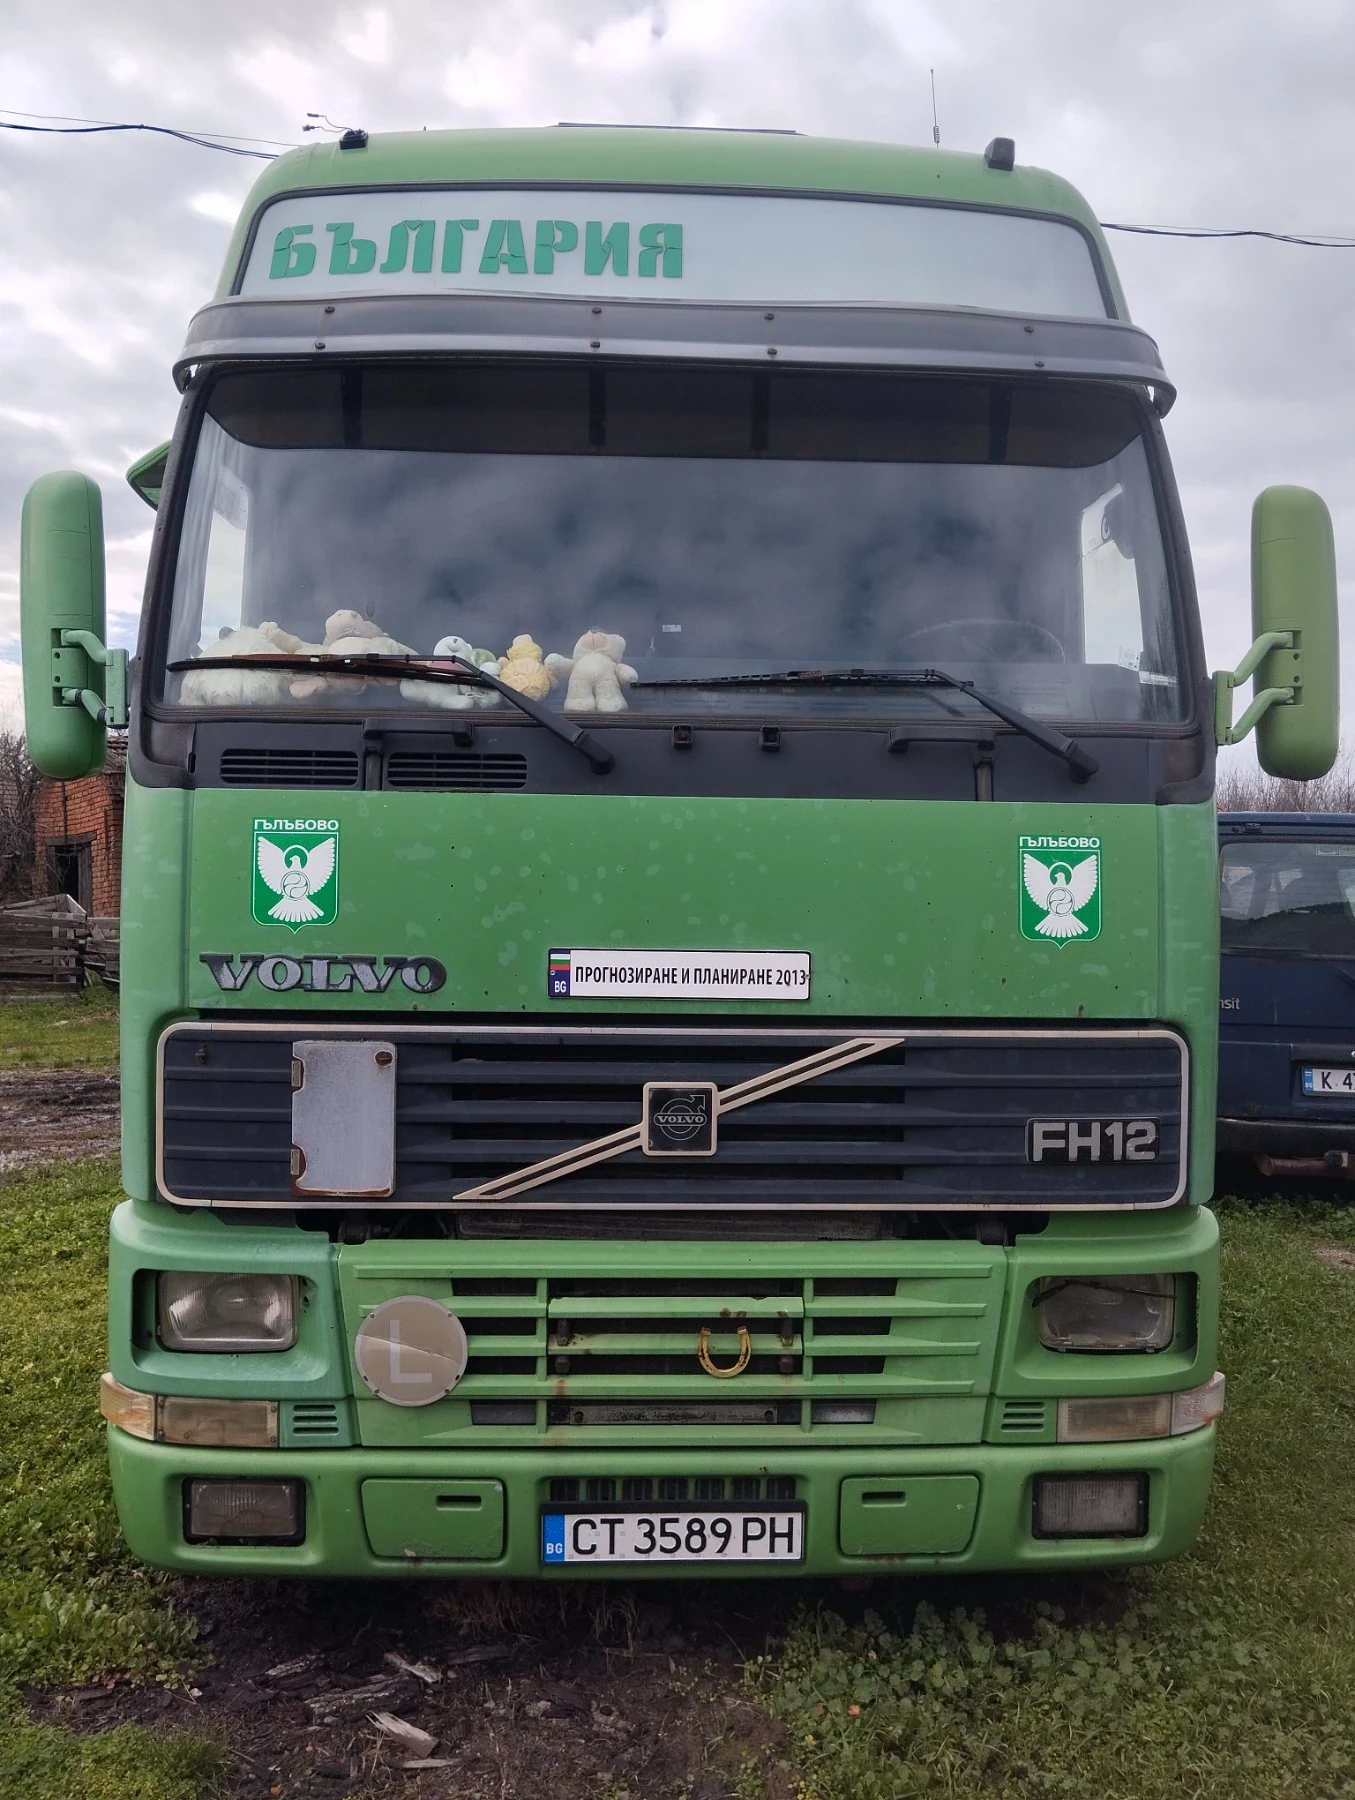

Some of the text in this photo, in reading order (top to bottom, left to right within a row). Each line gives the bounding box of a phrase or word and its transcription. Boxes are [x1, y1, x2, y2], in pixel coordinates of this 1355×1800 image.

[269, 219, 683, 280] БЪЛГАРИЯ
[254, 819, 340, 831] ГЪЛЪБОВО
[1019, 836, 1100, 848] ГЪЛЪБОВО
[199, 953, 447, 993] VOLVO
[575, 966, 678, 985] ПРОГНОЗИРАНЕ
[681, 968, 690, 985] И
[693, 968, 773, 985] ПЛАНИРАНЕ
[554, 980, 567, 993] BG
[656, 1115, 705, 1123] VOLVO
[1032, 1121, 1157, 1162] FH12
[389, 1319, 433, 1384] L
[572, 1516, 794, 1555] CT 3589 PH
[546, 1542, 563, 1554] BG
